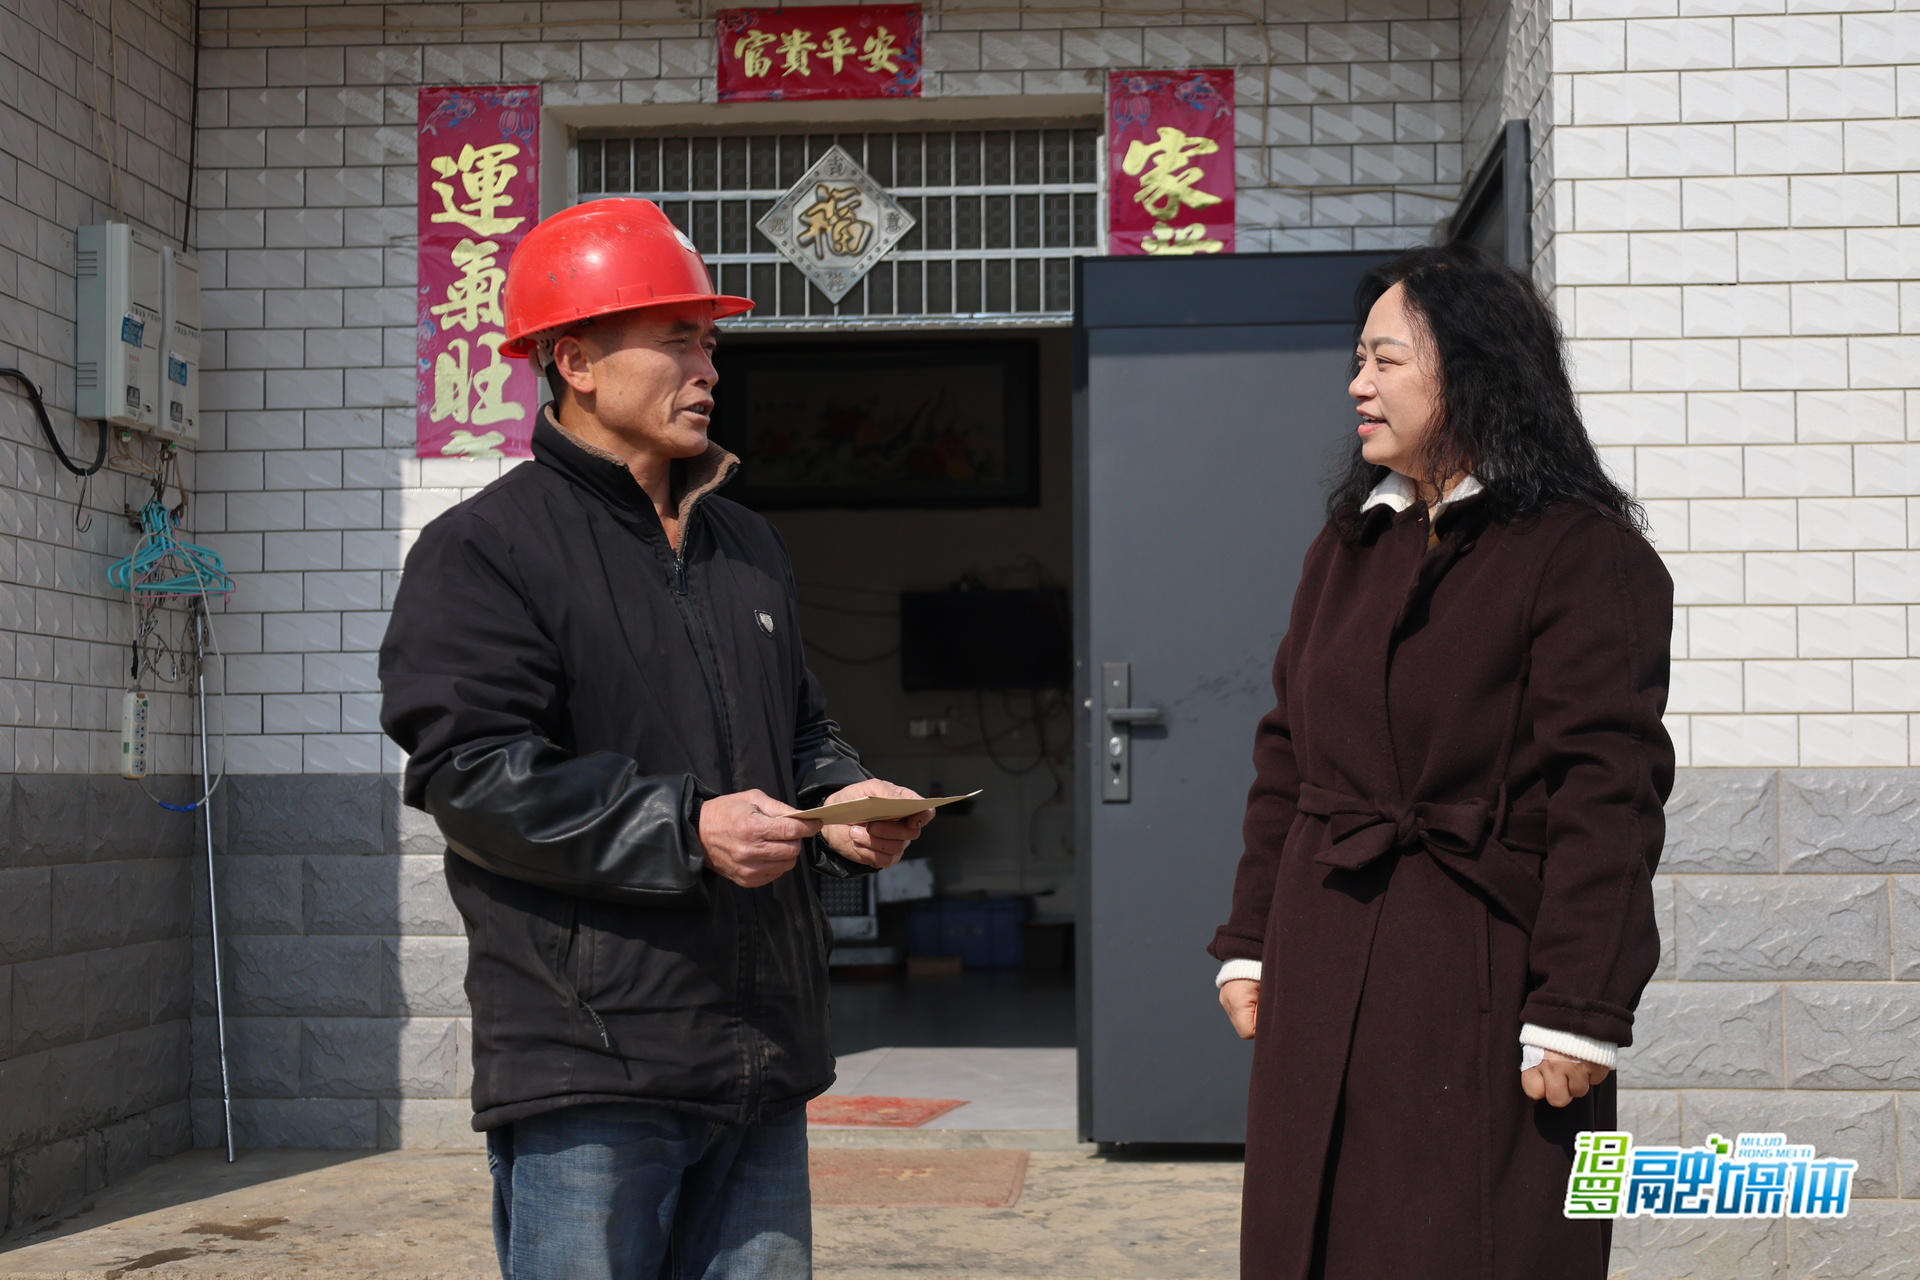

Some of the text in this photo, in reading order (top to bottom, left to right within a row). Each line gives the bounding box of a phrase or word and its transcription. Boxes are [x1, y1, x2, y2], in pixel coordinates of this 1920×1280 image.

[734, 26, 902, 78] 富貴平安
[797, 184, 875, 261] 福
